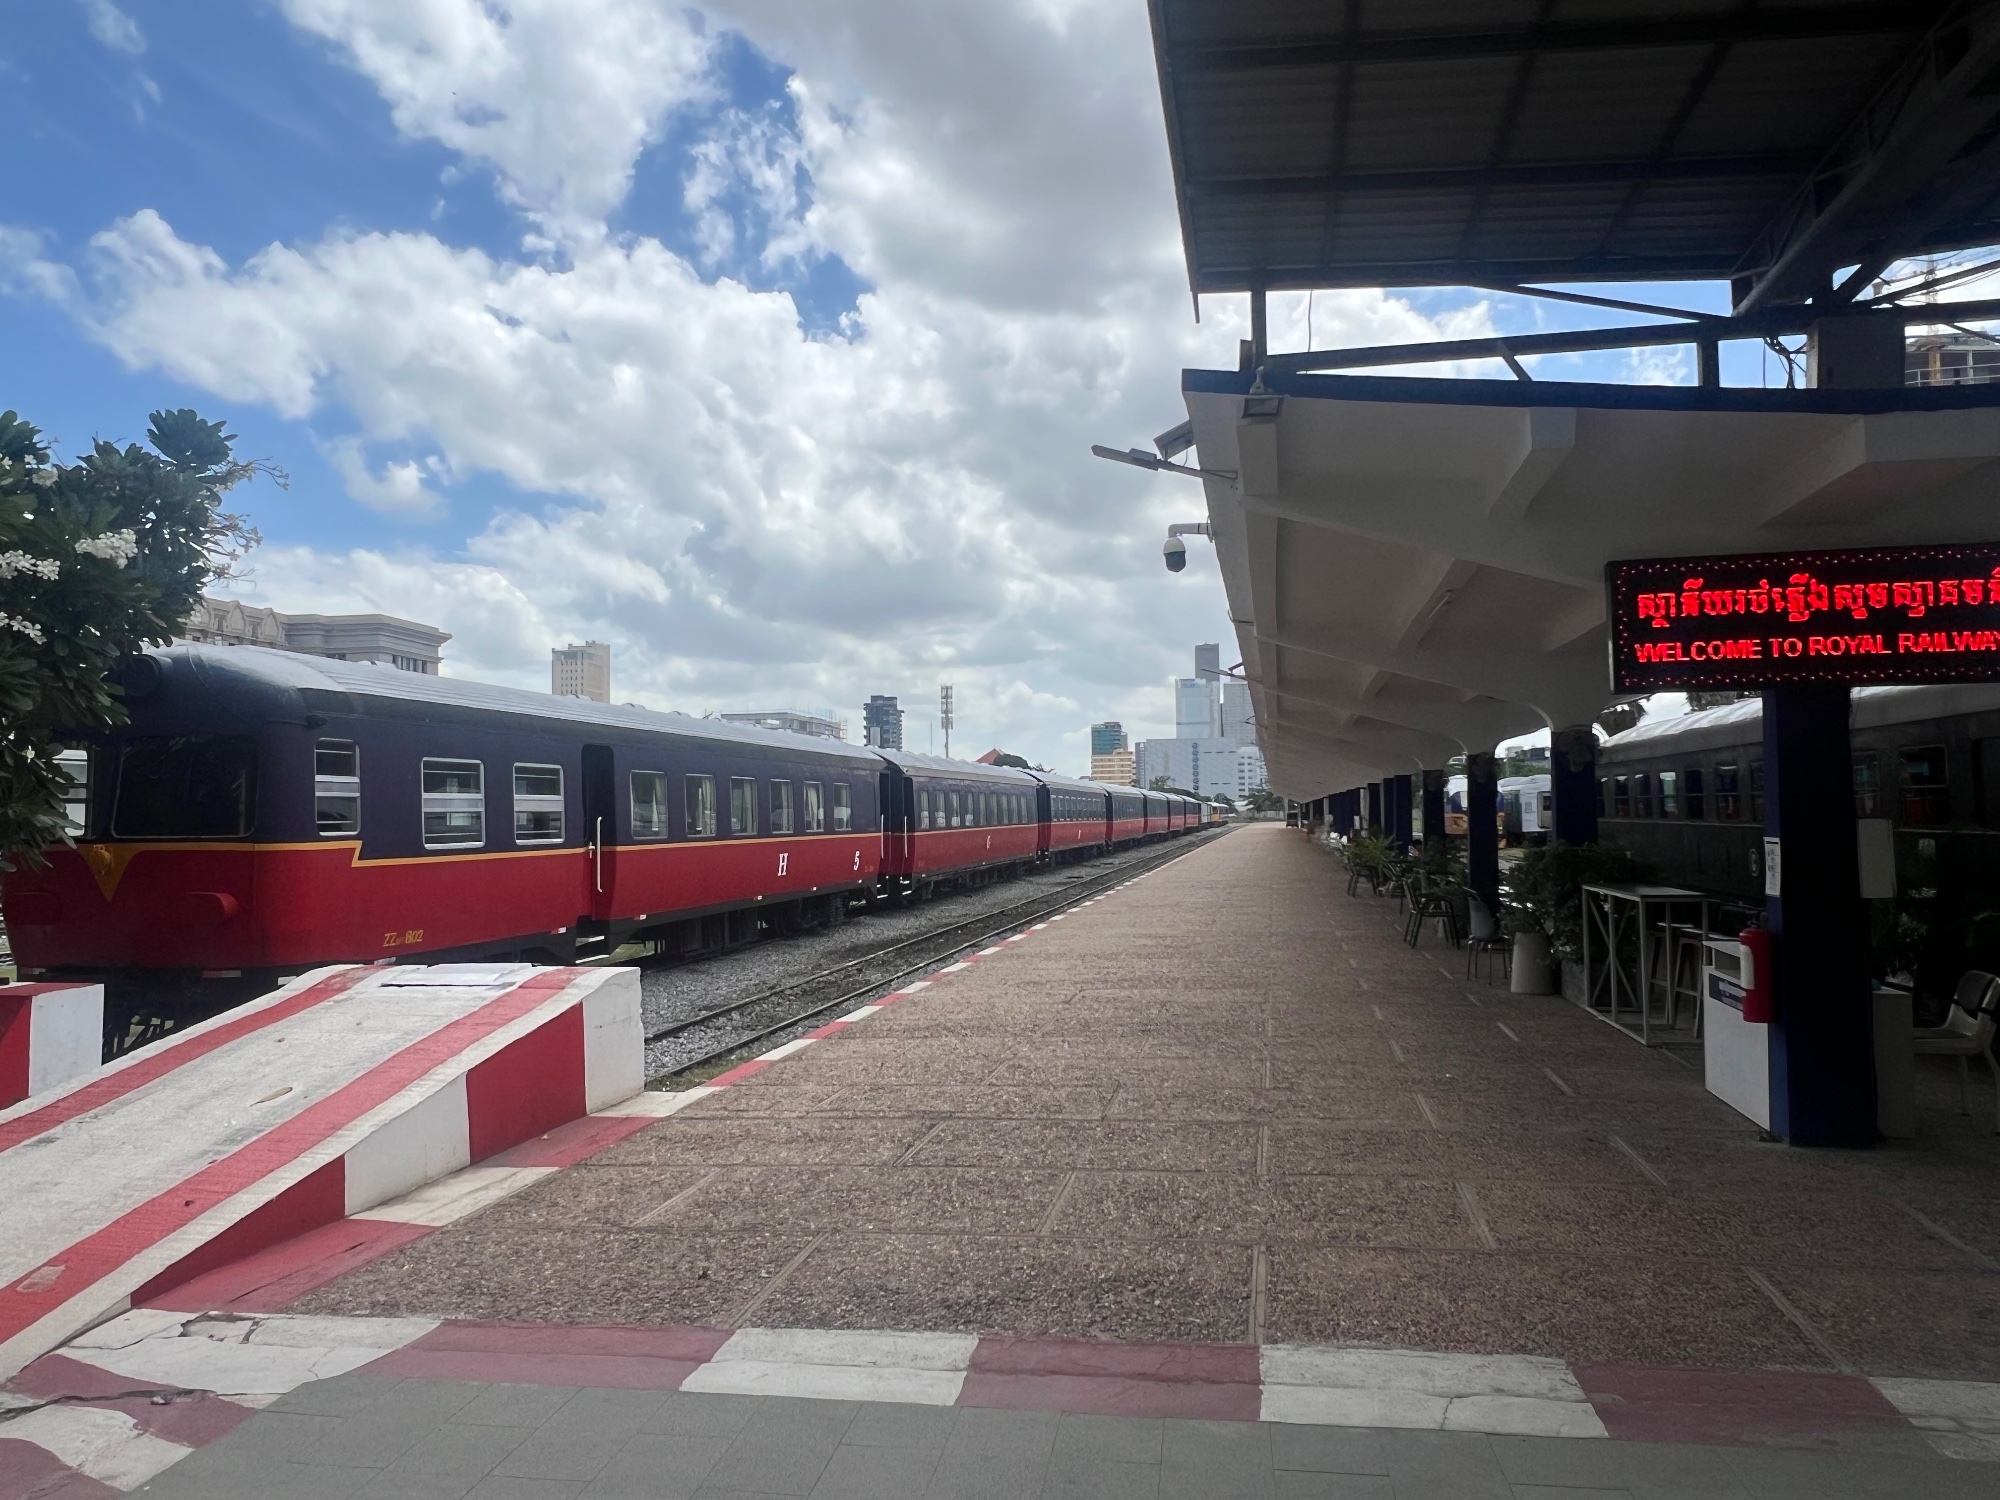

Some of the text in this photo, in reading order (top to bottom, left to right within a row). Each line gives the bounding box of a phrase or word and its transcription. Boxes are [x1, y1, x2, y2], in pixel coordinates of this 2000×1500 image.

[1634, 640, 1762, 662] WELCOME
[1769, 638, 1802, 657] TO
[1808, 634, 1892, 657] ROYAL
[777, 853, 788, 876] H
